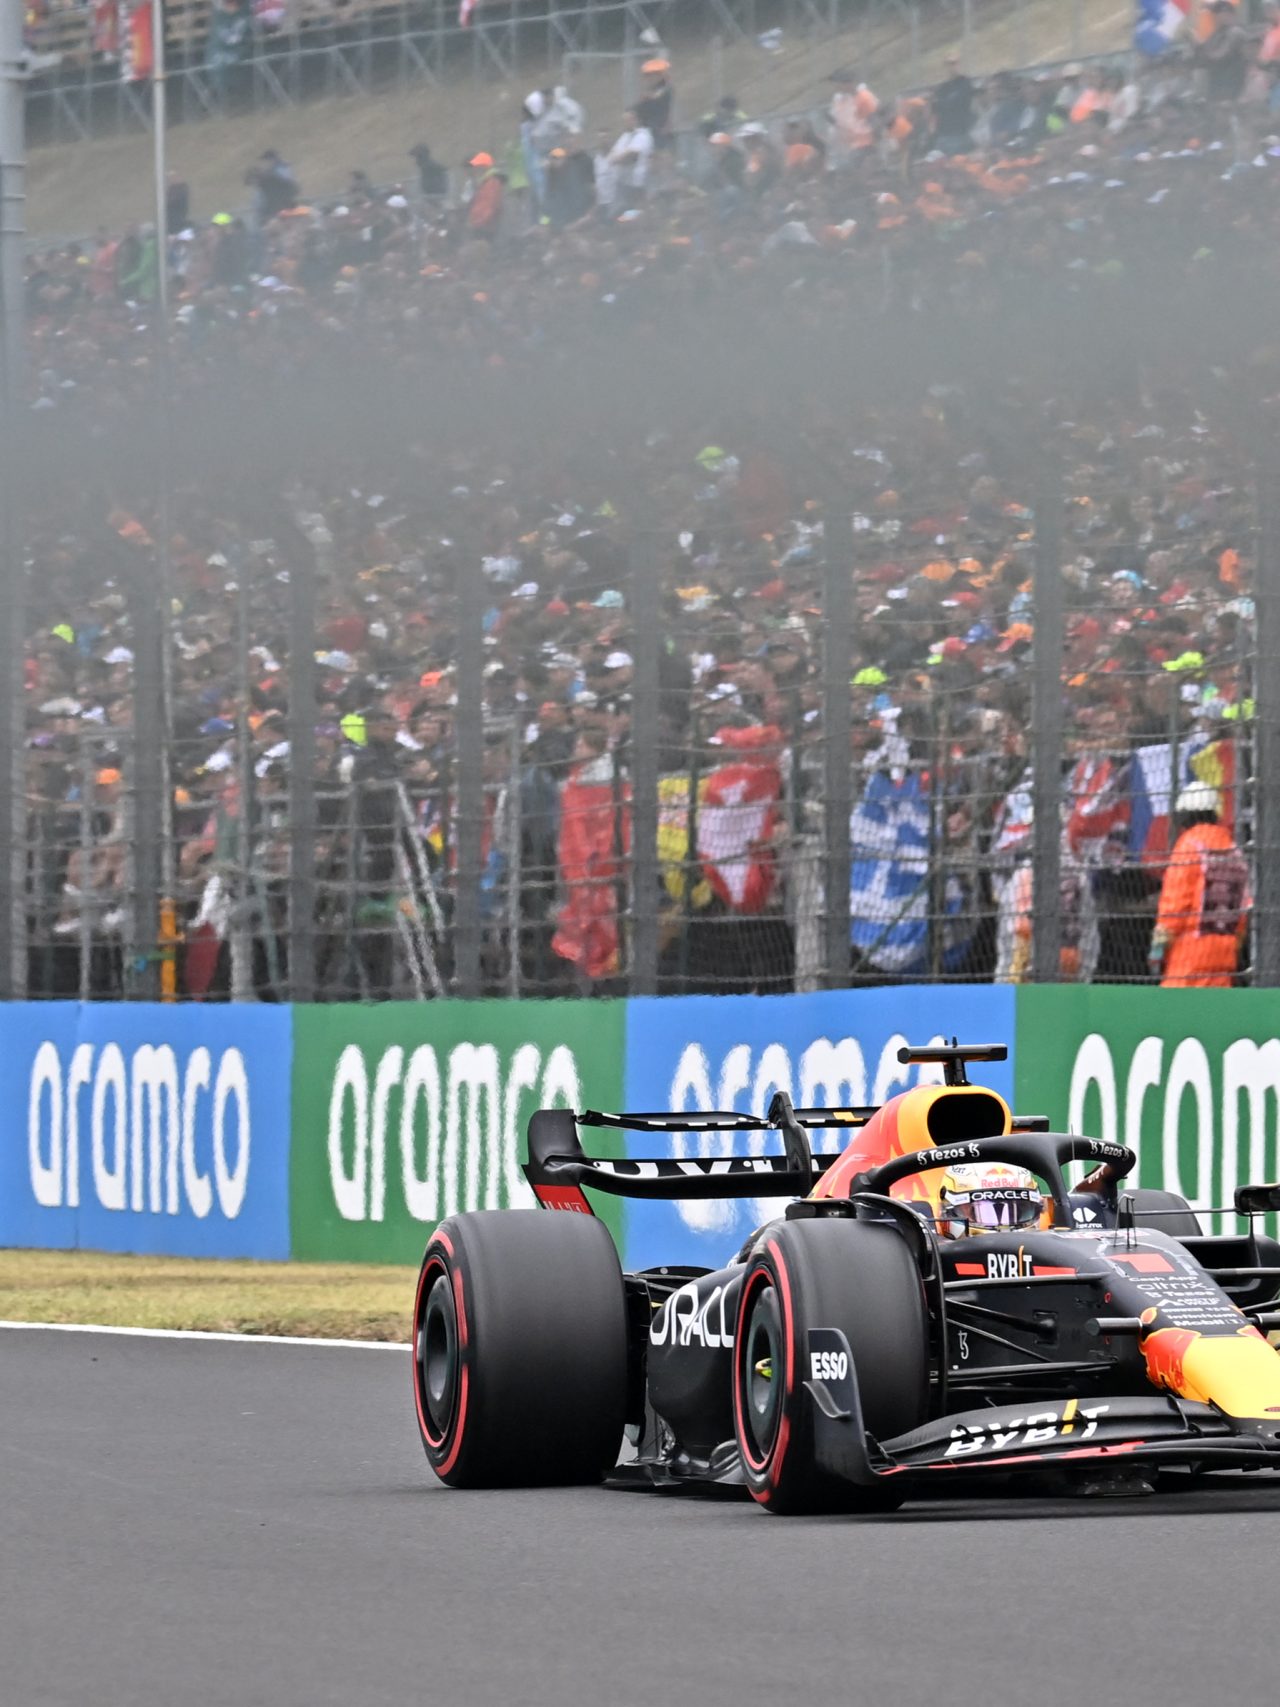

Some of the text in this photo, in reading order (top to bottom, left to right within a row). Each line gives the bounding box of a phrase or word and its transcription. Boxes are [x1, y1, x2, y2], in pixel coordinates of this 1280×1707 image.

[28, 1040, 250, 1219] aramco
[929, 1147, 966, 1161] Tezos
[1099, 1141, 1123, 1157] Tezos
[981, 1177, 1019, 1188] Red Bull
[971, 1190, 1029, 1201] ORACLE
[987, 1245, 1032, 1279] BYBIT
[810, 1351, 848, 1380] ESSO
